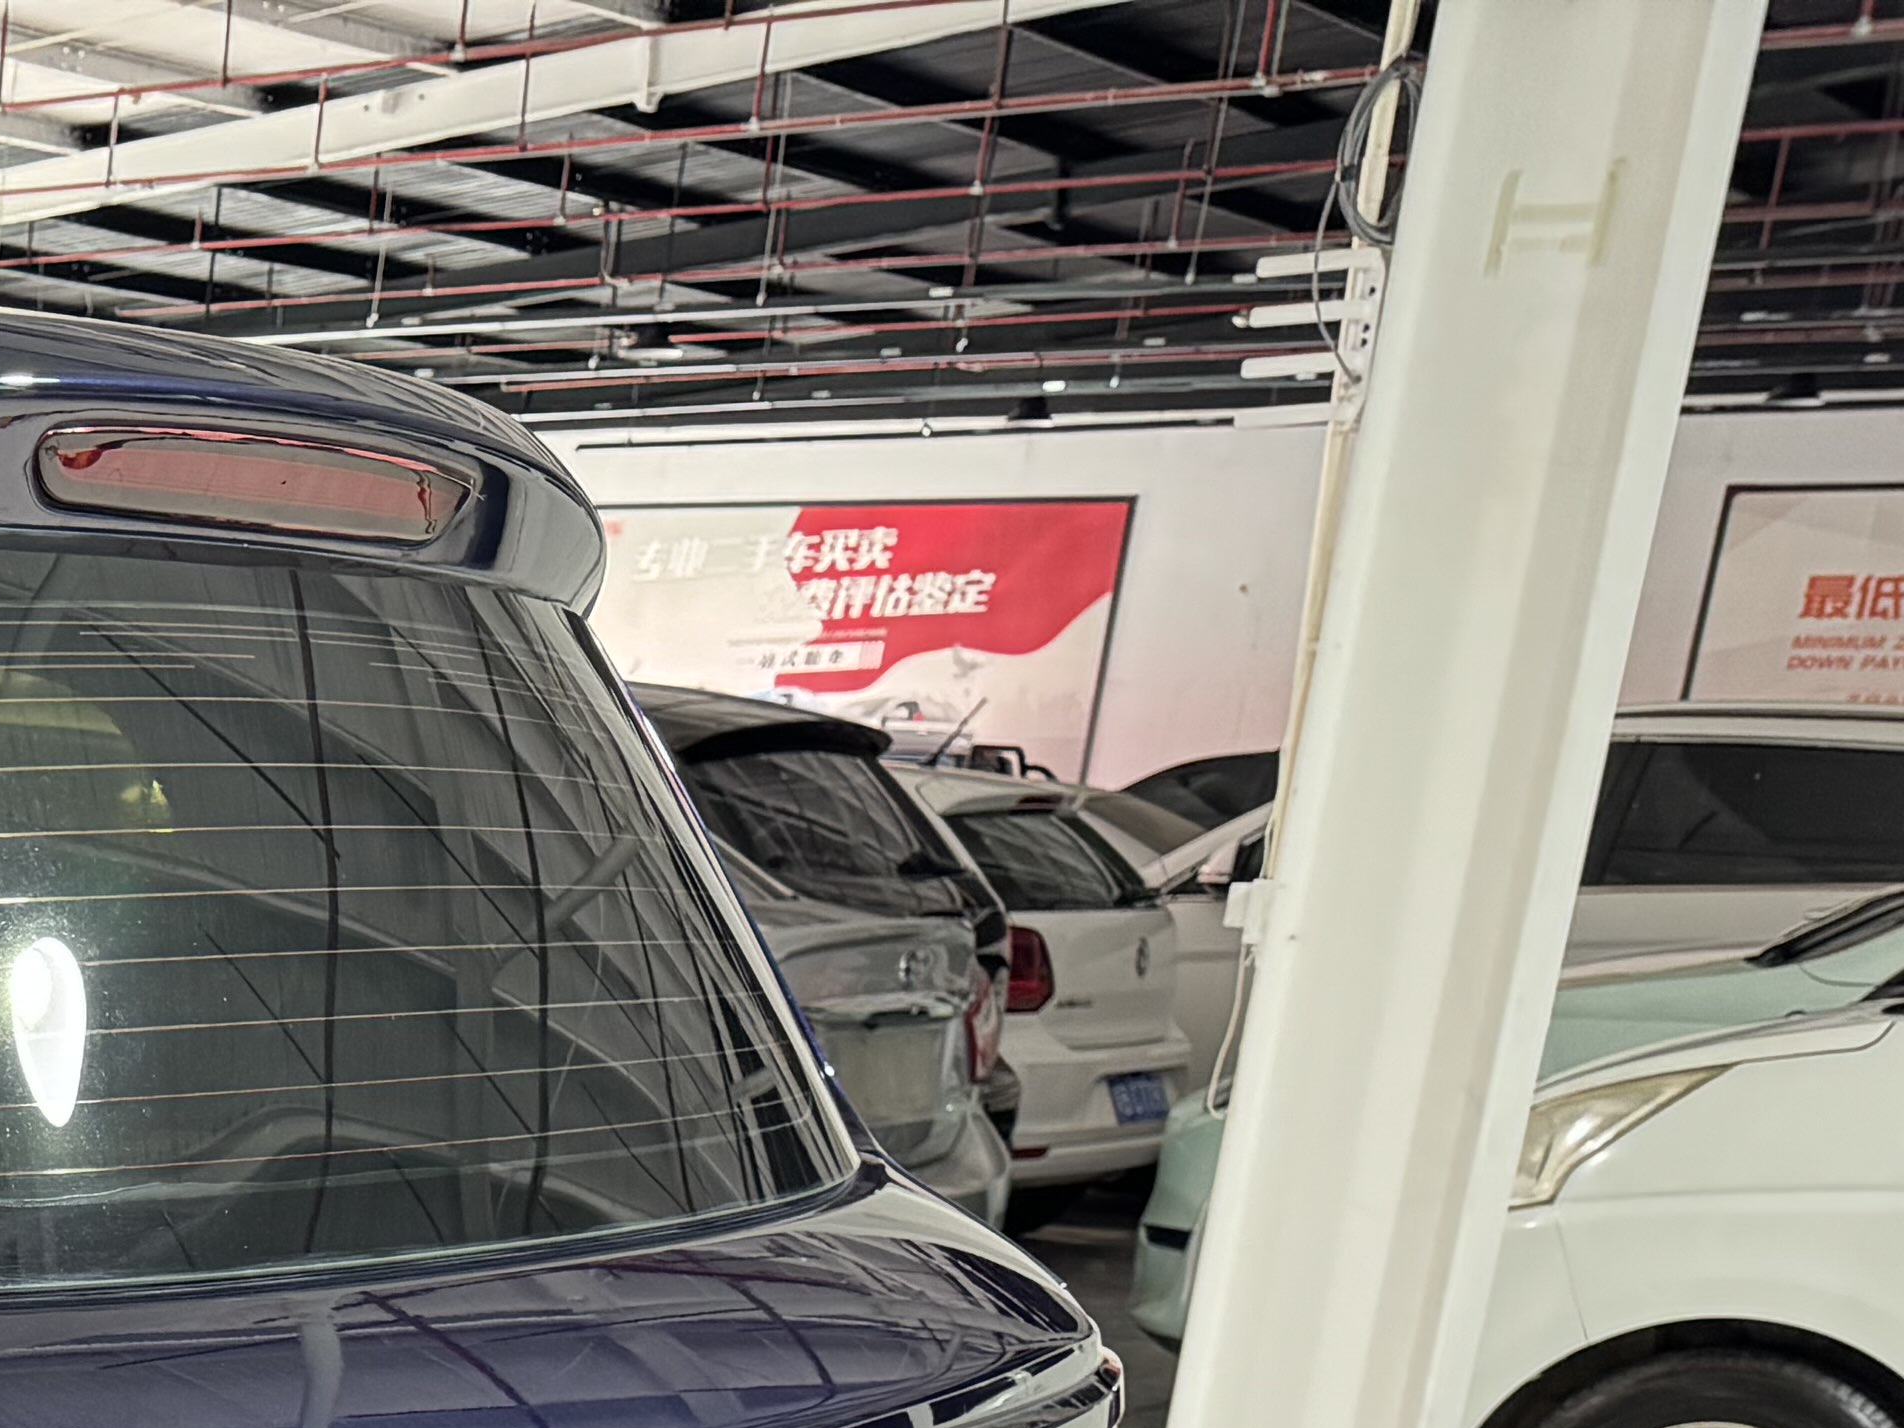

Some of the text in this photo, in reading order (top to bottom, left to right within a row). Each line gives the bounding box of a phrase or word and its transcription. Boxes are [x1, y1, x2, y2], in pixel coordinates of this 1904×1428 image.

[632, 525, 898, 582] 专业二手车买卖
[757, 569, 996, 622] 费评估鉴定
[1798, 575, 1904, 619] 最低
[1786, 656, 1853, 670] DOWN
